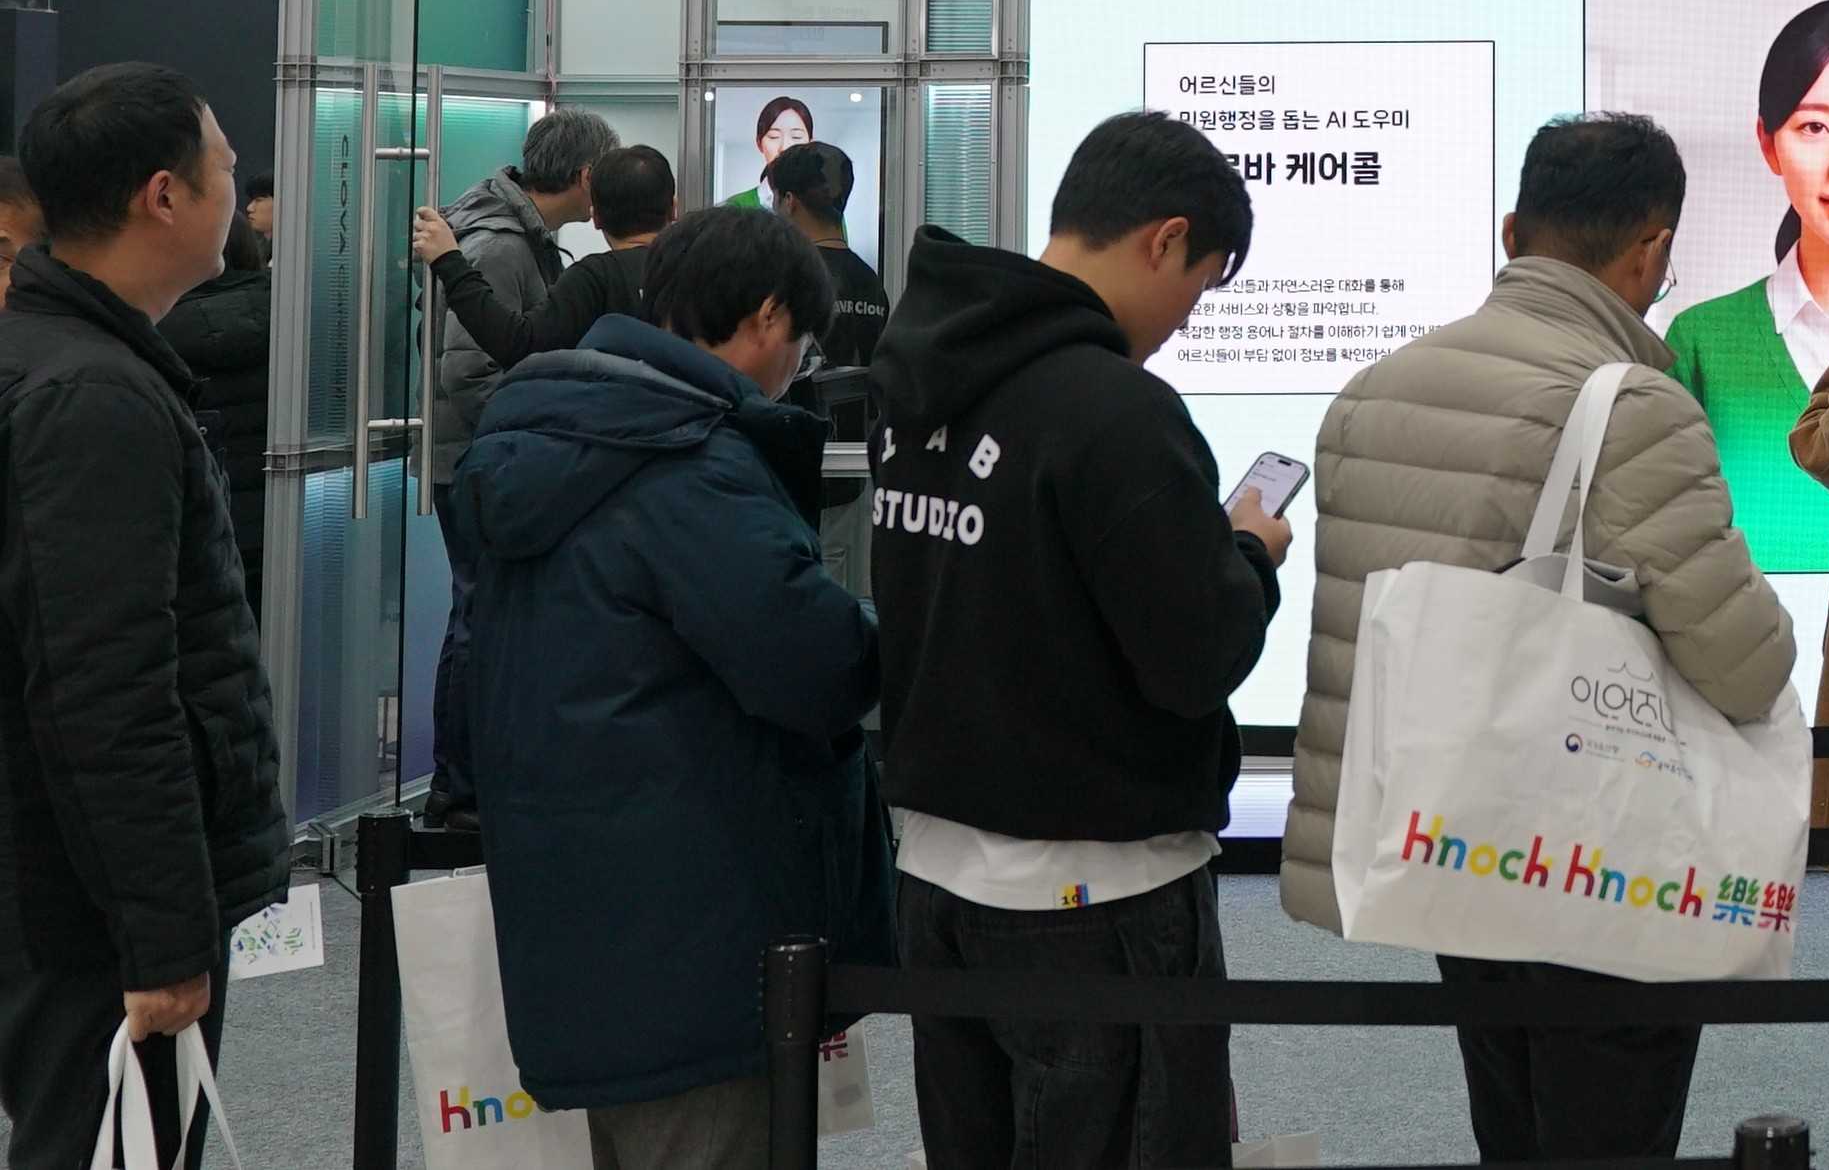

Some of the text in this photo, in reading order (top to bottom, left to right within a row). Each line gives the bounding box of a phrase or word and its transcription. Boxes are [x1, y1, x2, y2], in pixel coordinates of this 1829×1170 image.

[1179, 75, 1276, 95] 어르신들의
[1282, 110, 1320, 130] 돕는
[1326, 111, 1346, 129] AI
[1352, 109, 1410, 130] 도우미
[1285, 151, 1383, 186] 케어콜
[1272, 278, 1335, 293] 자연스러운
[1219, 302, 1268, 316] 서비스와
[1218, 325, 1243, 340] 행정
[1247, 325, 1284, 340] 용어나
[1328, 325, 1379, 339] 이해하기
[1383, 325, 1407, 339] 쉽게
[1177, 348, 1241, 363] 어르신들이
[1243, 348, 1268, 363] 부담
[1271, 348, 1297, 363] 없이
[1299, 348, 1337, 363] 정보를
[872, 486, 985, 546] STUDIO
